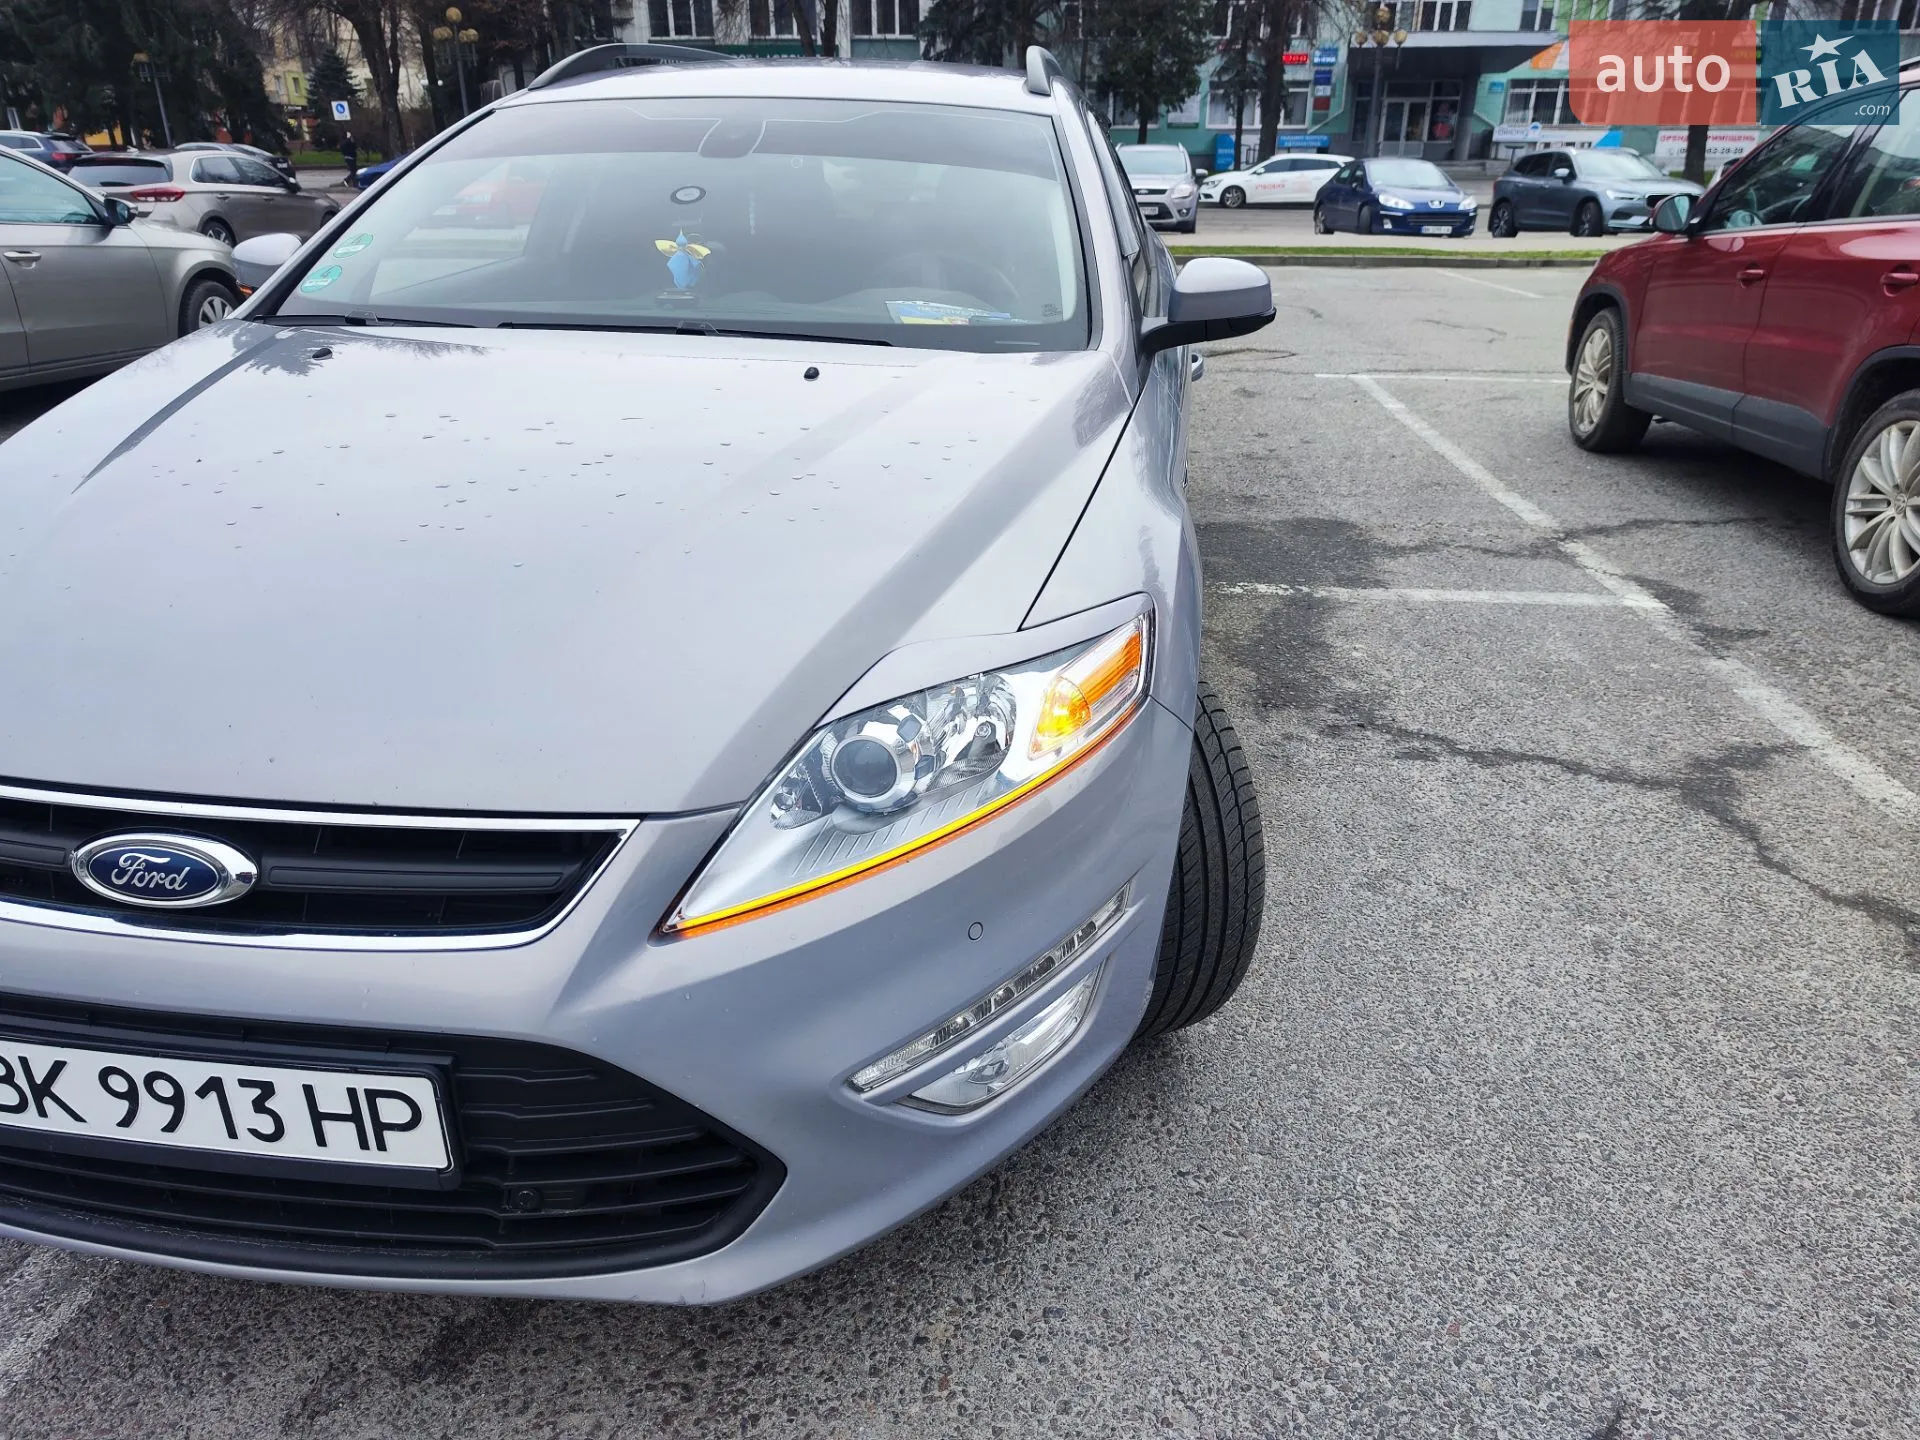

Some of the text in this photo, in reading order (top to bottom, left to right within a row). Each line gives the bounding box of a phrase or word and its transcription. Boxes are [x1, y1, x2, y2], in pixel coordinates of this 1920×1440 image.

[111, 852, 191, 891] Ford
[97, 1065, 286, 1144] 9913
[302, 1083, 423, 1152] HP
